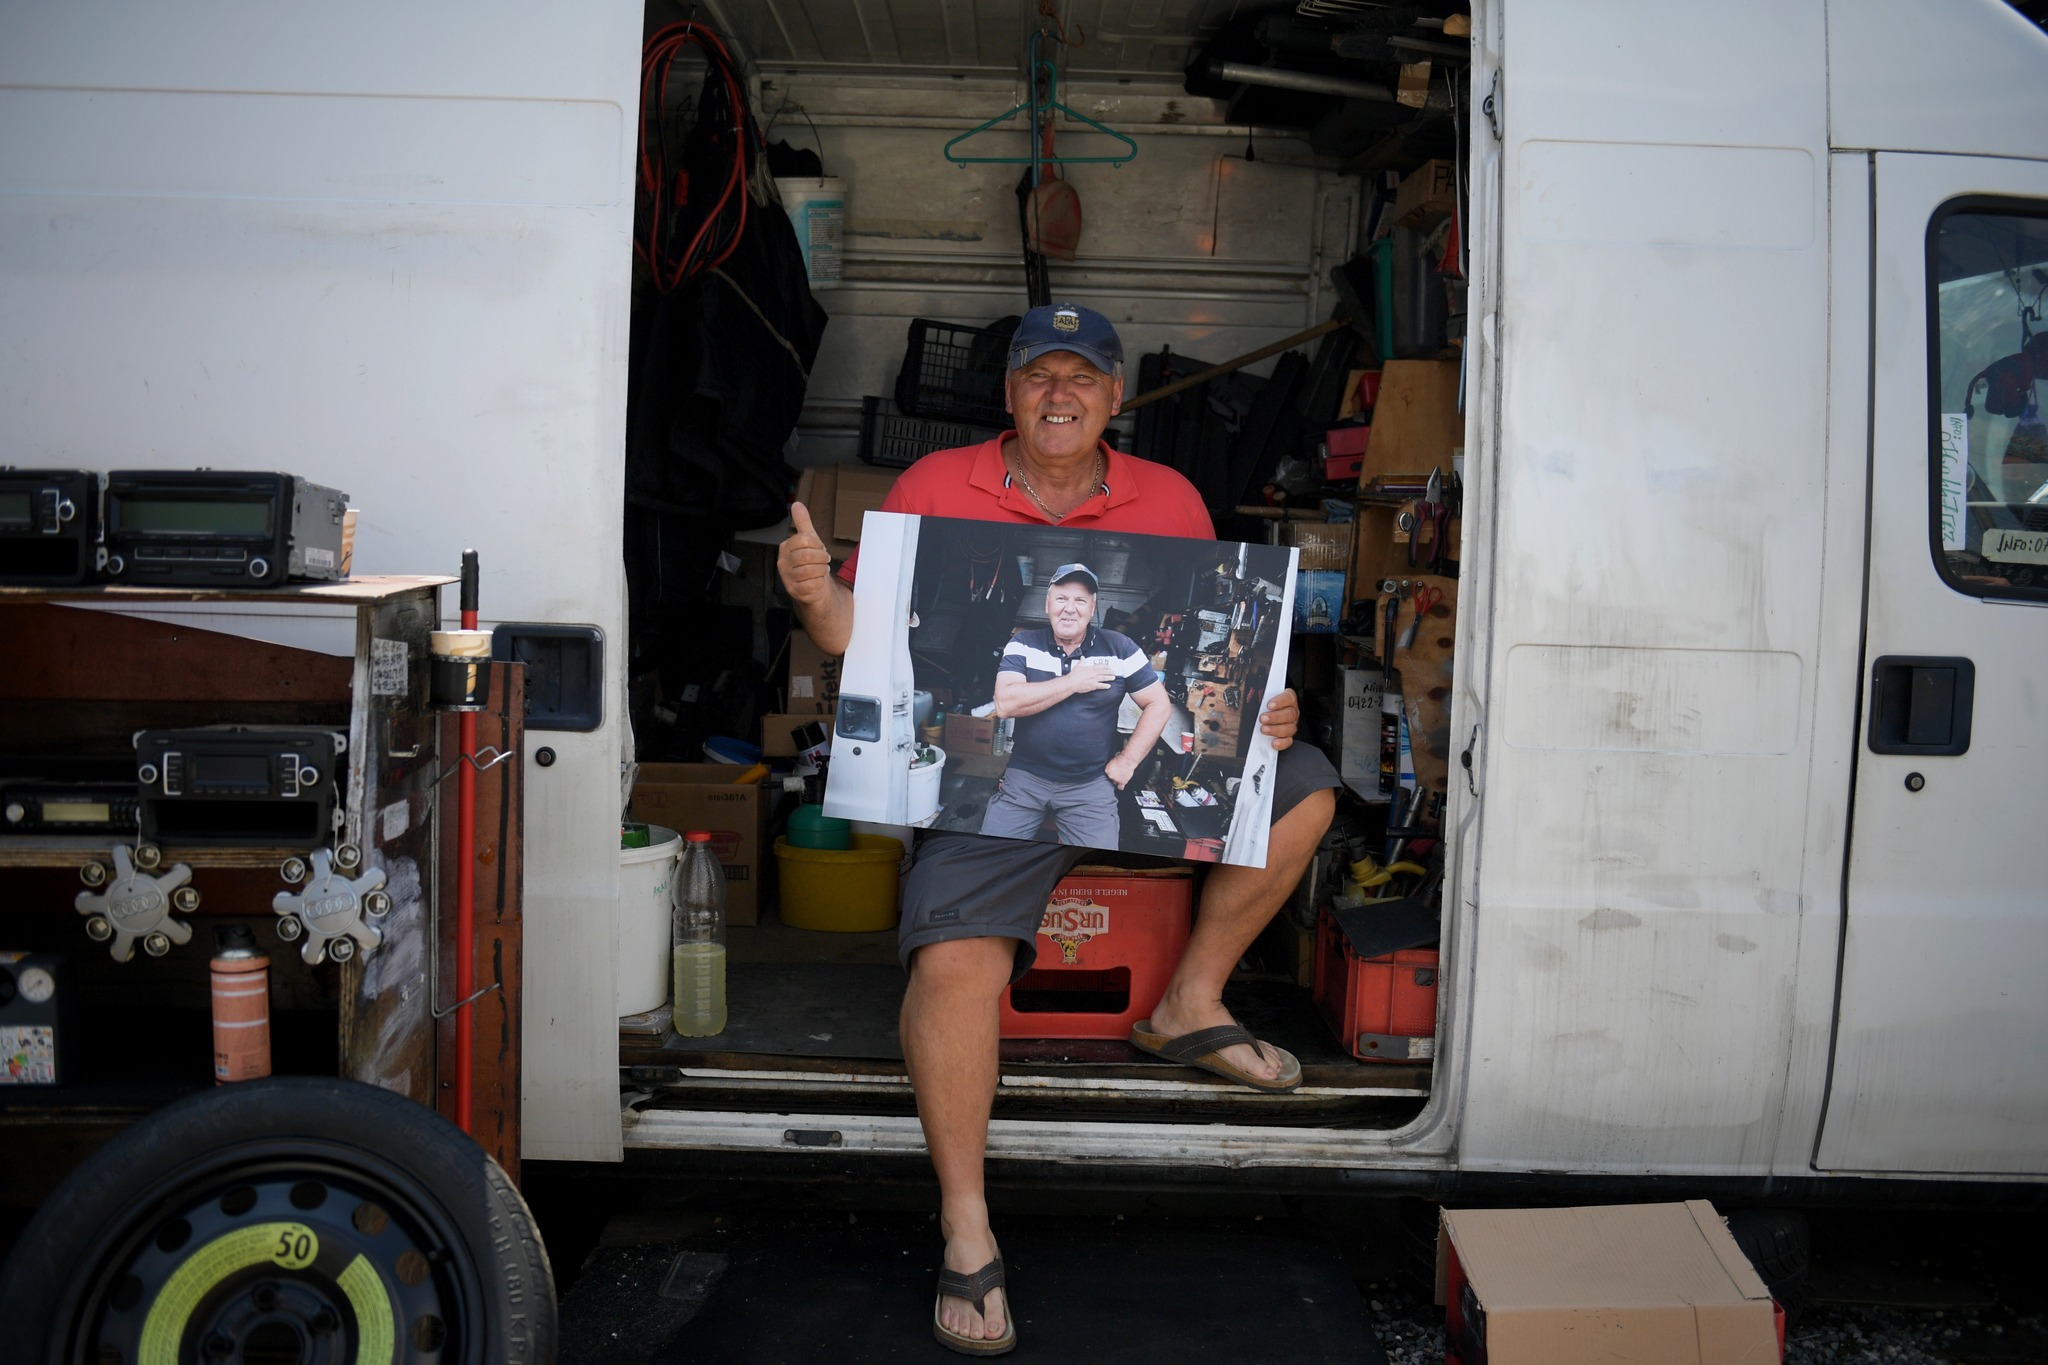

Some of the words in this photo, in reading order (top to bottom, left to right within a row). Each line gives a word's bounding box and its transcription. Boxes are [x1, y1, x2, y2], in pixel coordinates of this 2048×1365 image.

[1058, 315, 1074, 326] AFA
[1039, 909, 1104, 932] URSUS
[275, 1231, 311, 1261] 50
